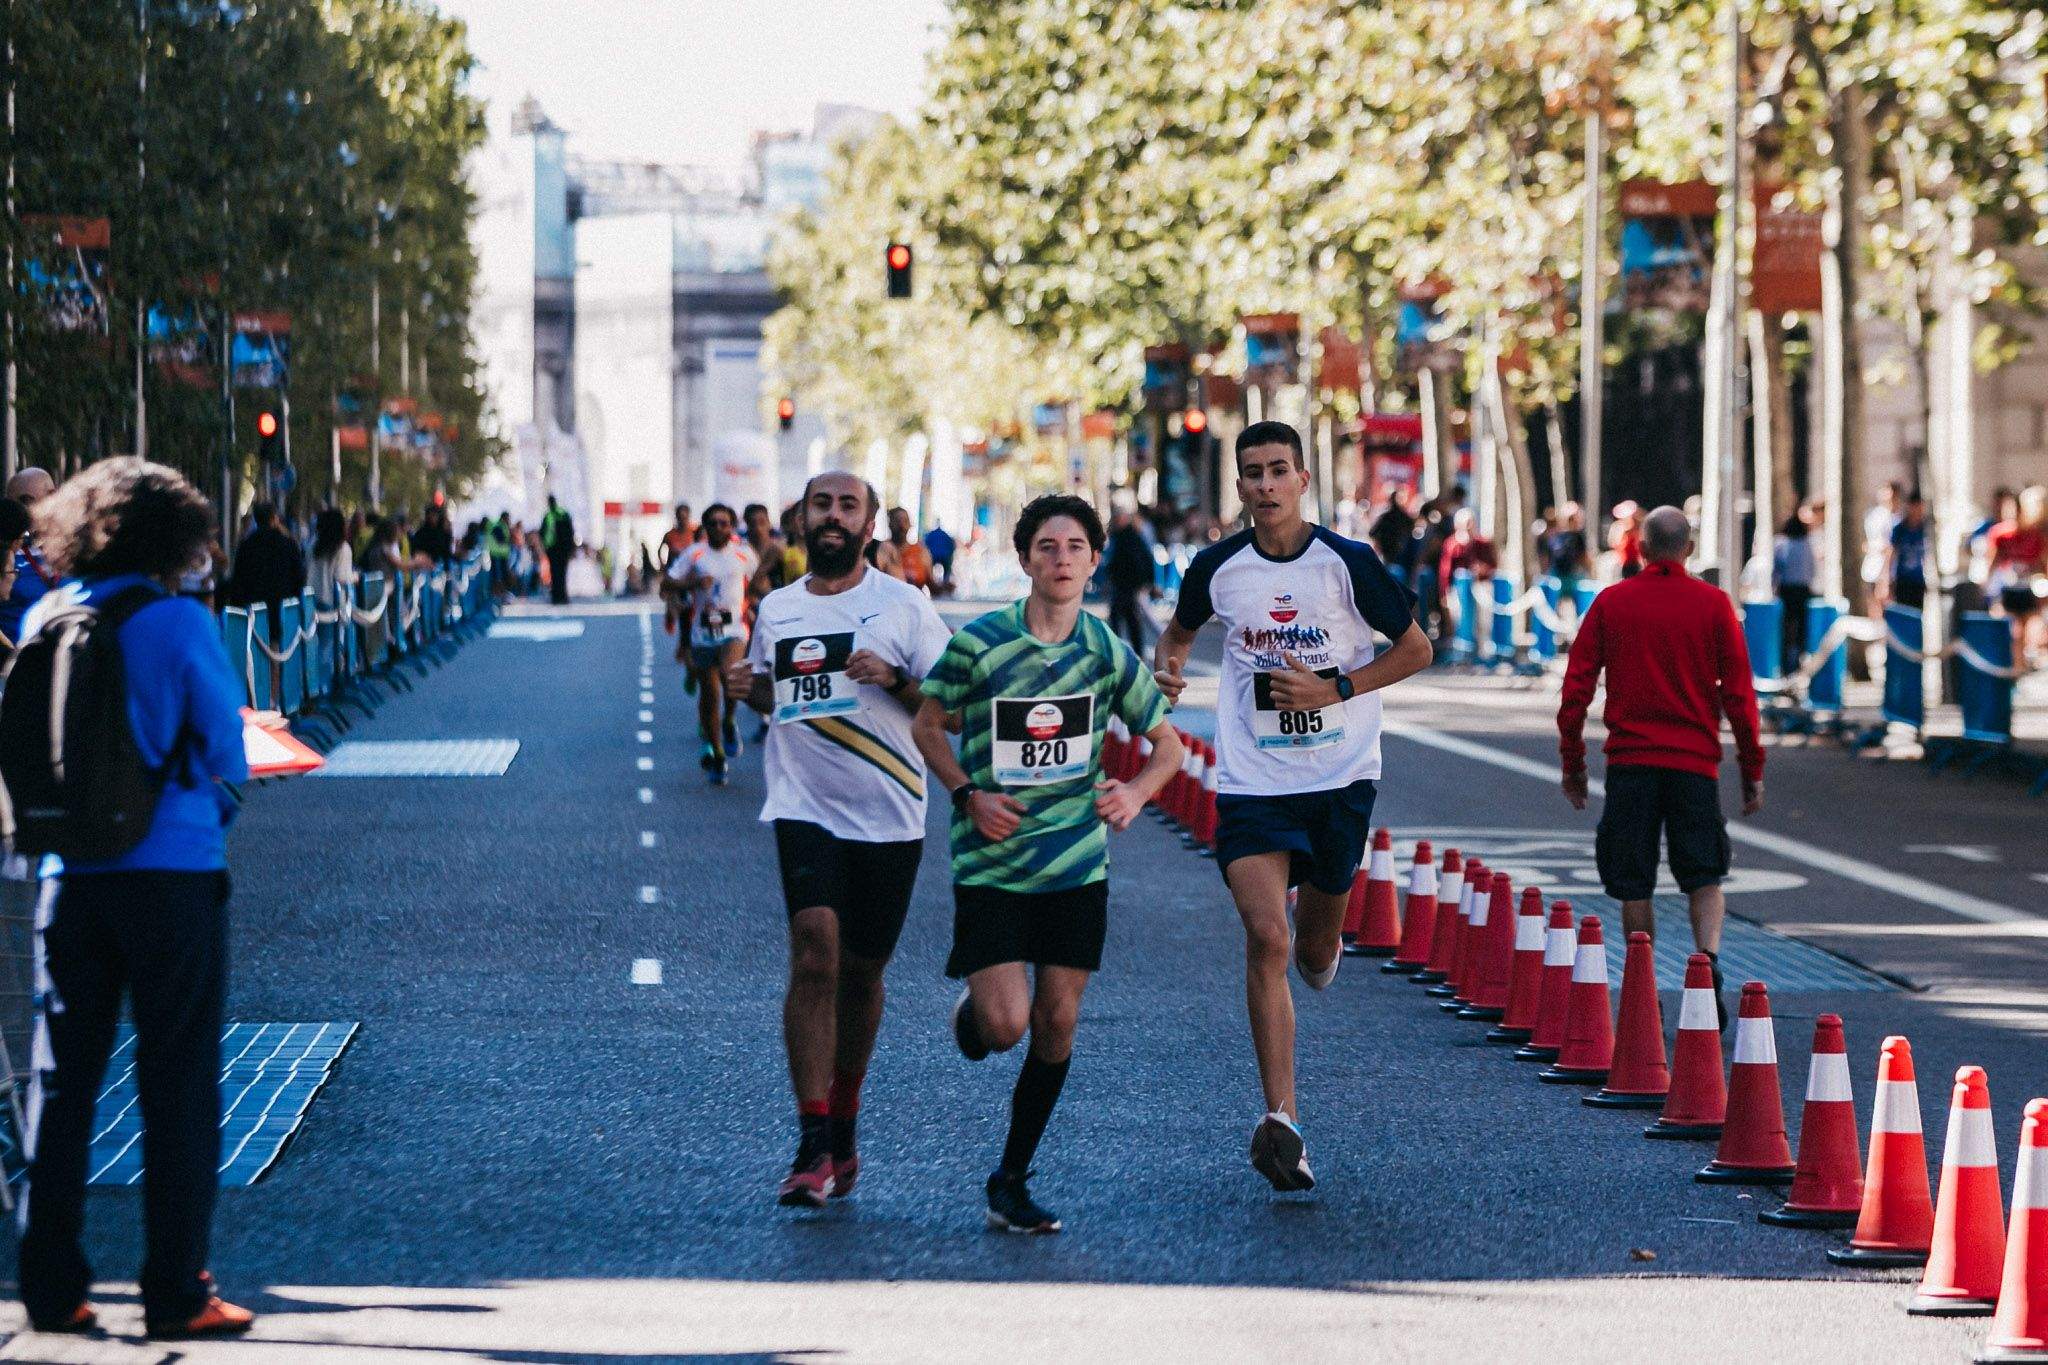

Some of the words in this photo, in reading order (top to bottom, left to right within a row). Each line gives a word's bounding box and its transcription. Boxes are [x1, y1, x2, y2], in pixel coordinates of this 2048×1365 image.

[790, 674, 832, 703] 798
[1279, 710, 1323, 735] 805
[1021, 740, 1068, 768] 820
